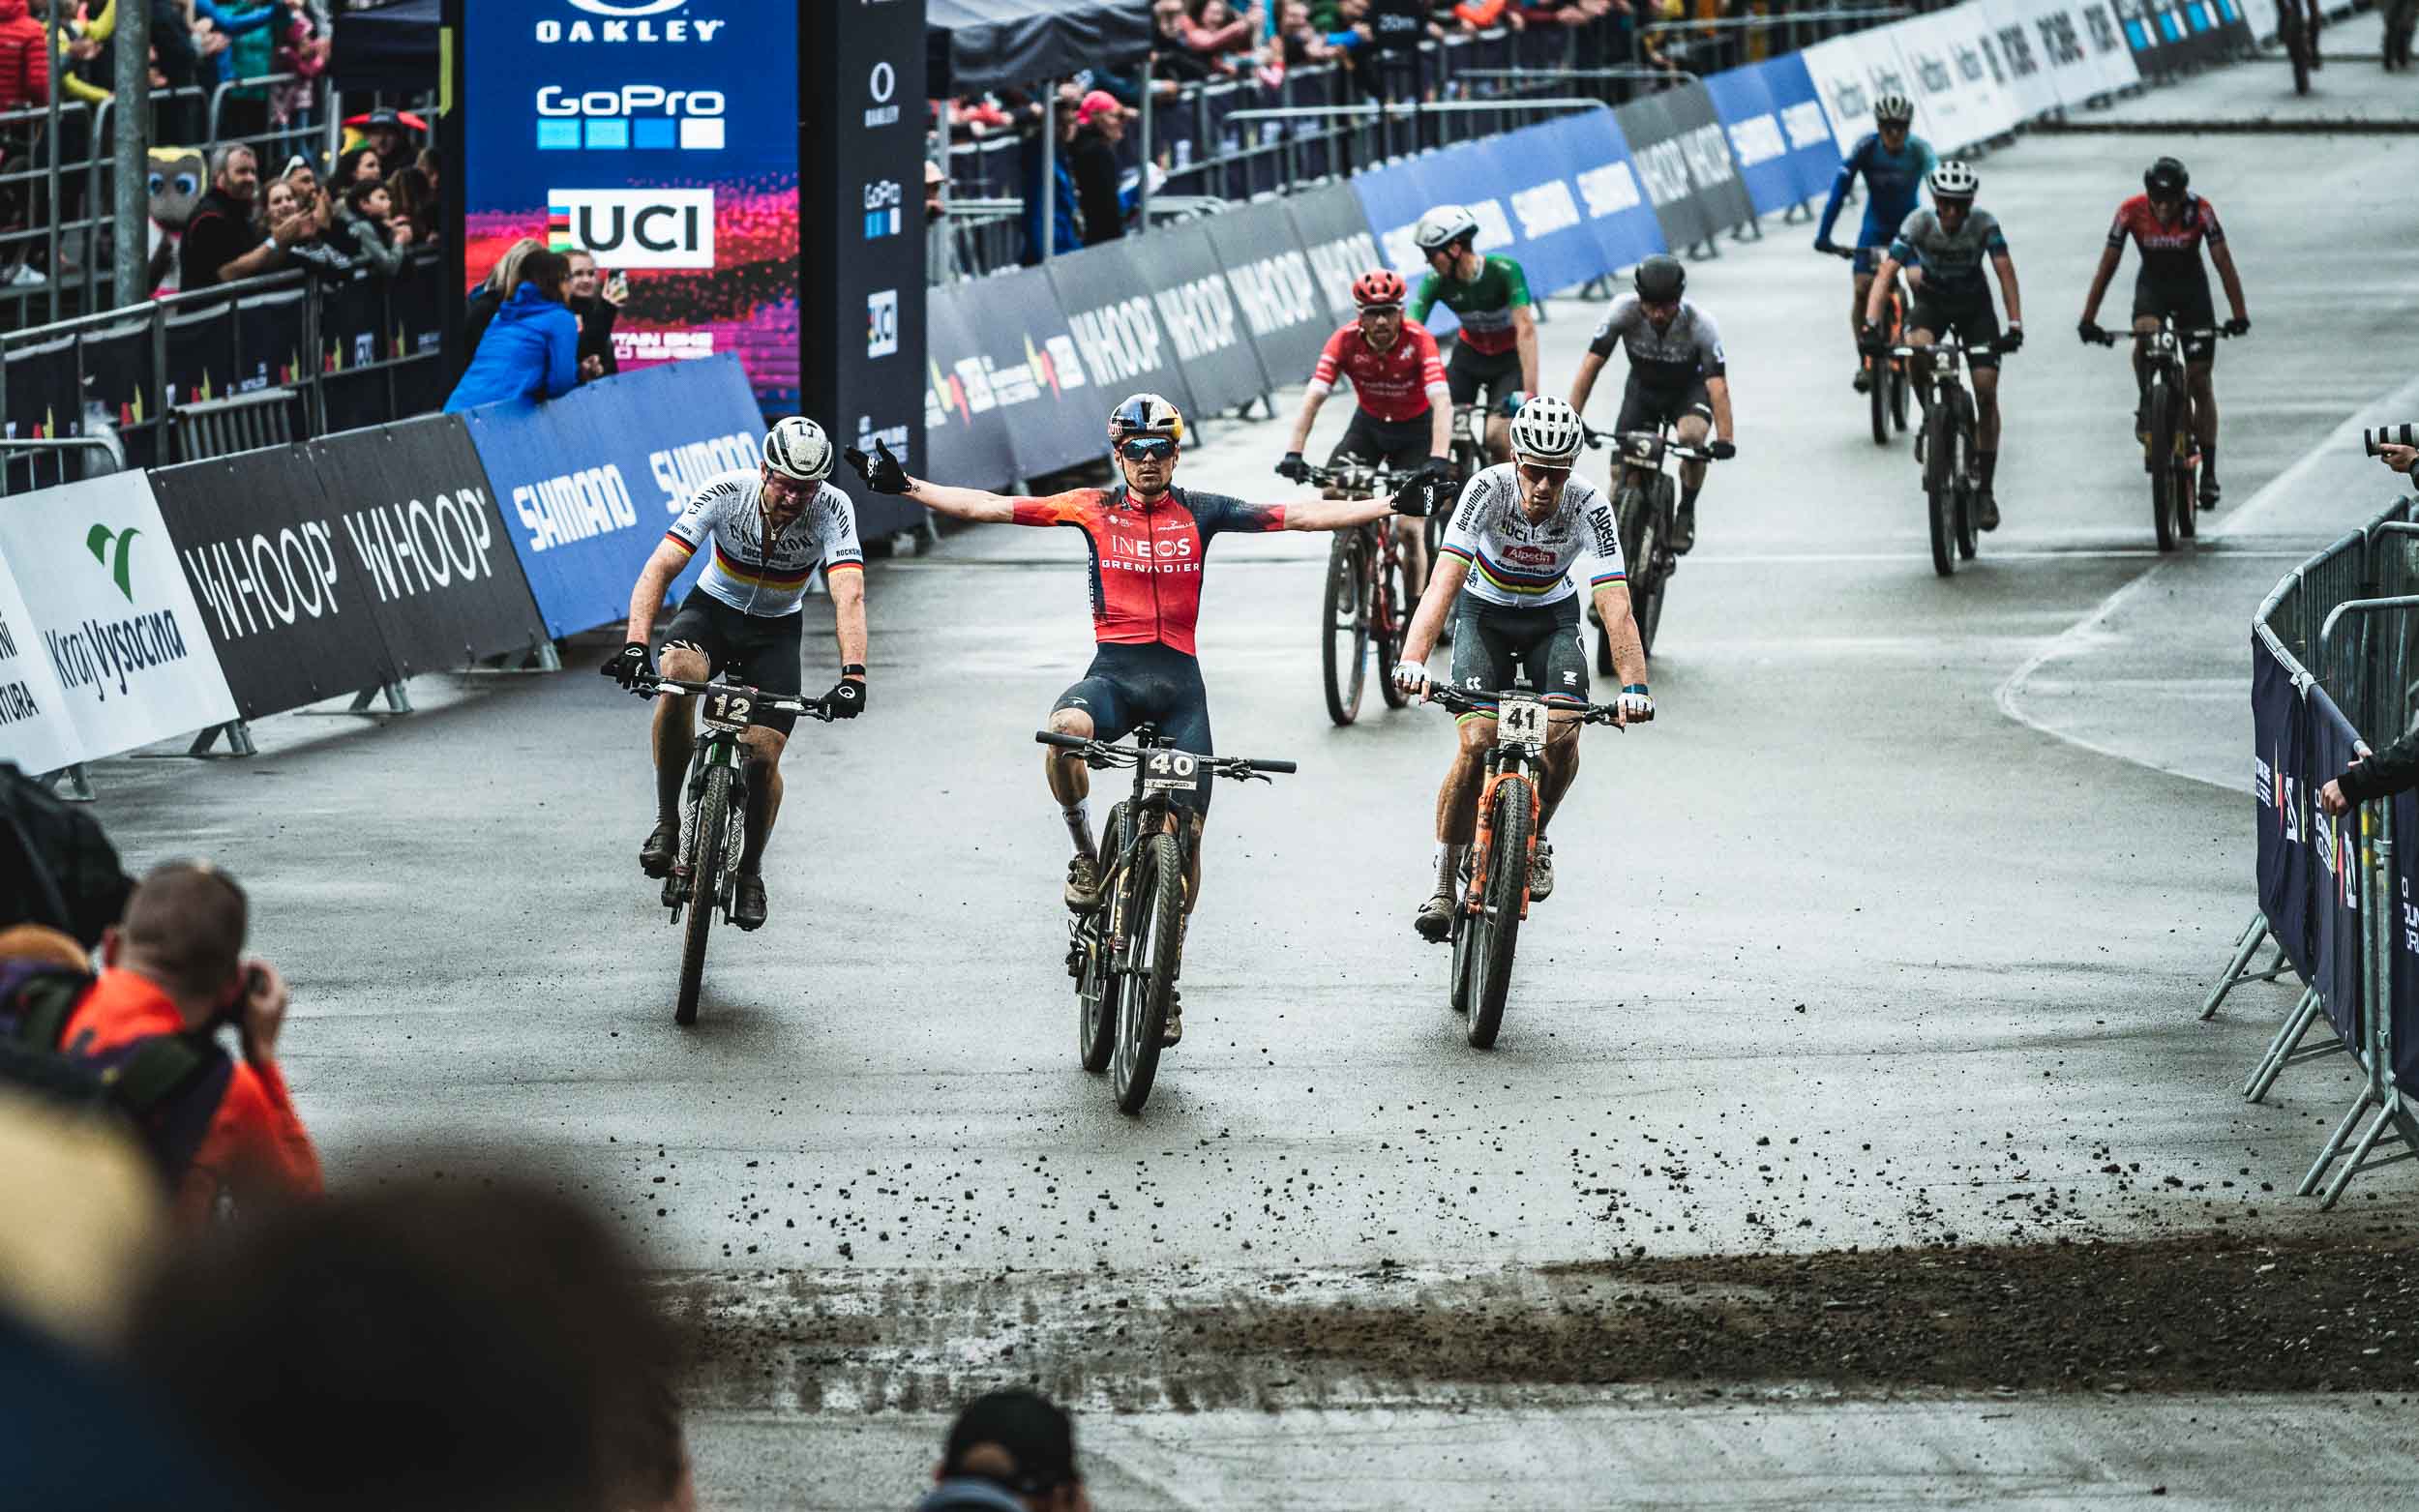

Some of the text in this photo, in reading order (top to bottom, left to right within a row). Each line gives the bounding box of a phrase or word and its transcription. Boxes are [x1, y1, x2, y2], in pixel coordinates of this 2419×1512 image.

[536, 19, 725, 43] OAKLEY
[536, 85, 725, 116] GoPro
[579, 204, 699, 252] UCI
[1068, 296, 1162, 387] WHOOP
[1154, 274, 1238, 362] WHOOP
[1226, 252, 1316, 336] WHOOP
[513, 463, 638, 552] SHIMANO
[688, 482, 737, 515] CANYON
[820, 491, 851, 539] CANYON
[1456, 479, 1491, 532] deceuninck
[1112, 535, 1191, 558] INEOS
[1590, 505, 1617, 557] Alpecin
[185, 487, 493, 640] WHOOP WHOOP
[1101, 559, 1200, 574] GRENADIER
[1508, 548, 1550, 562] Alpecin
[45, 630, 105, 702] Kraj
[0, 680, 40, 726] TURA
[714, 693, 751, 723] 12
[1508, 707, 1536, 730] 41
[1150, 752, 1194, 776] 40
